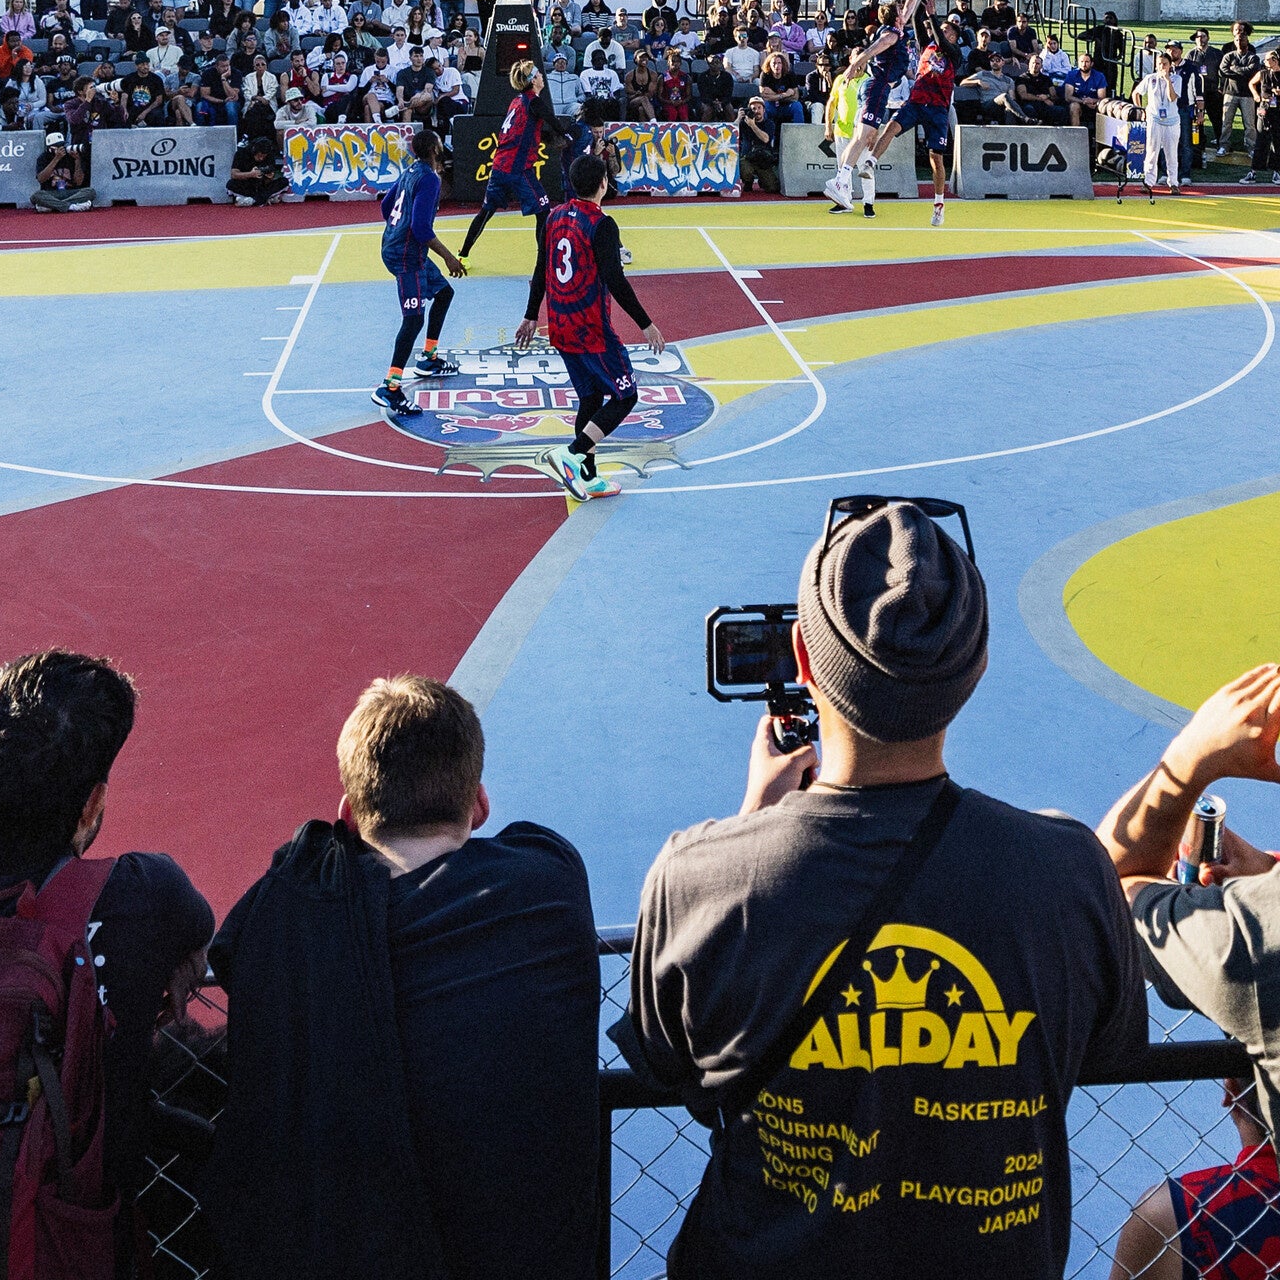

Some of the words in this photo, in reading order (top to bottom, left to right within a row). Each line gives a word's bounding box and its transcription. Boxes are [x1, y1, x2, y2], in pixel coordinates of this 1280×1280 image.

[496, 23, 530, 33] SPALDING
[501, 108, 516, 134] 4
[863, 112, 874, 121] 49
[112, 155, 216, 181] SPALDING
[982, 142, 1067, 173] FILA
[391, 190, 406, 226] 4
[539, 195, 549, 206] 35
[556, 237, 573, 284] 3
[403, 297, 418, 310] 49
[616, 374, 632, 391] 35
[789, 1011, 1036, 1073] ALLDAY
[914, 1094, 1048, 1121] BASKETBALL
[753, 1109, 880, 1158] TOURNAMENT
[758, 1127, 834, 1163] SPRING
[762, 1166, 818, 1214] TOKYO
[977, 1202, 1041, 1234] JAPAN
[832, 1183, 881, 1213] PARK
[899, 1176, 1044, 1207] PLAYGROUND
